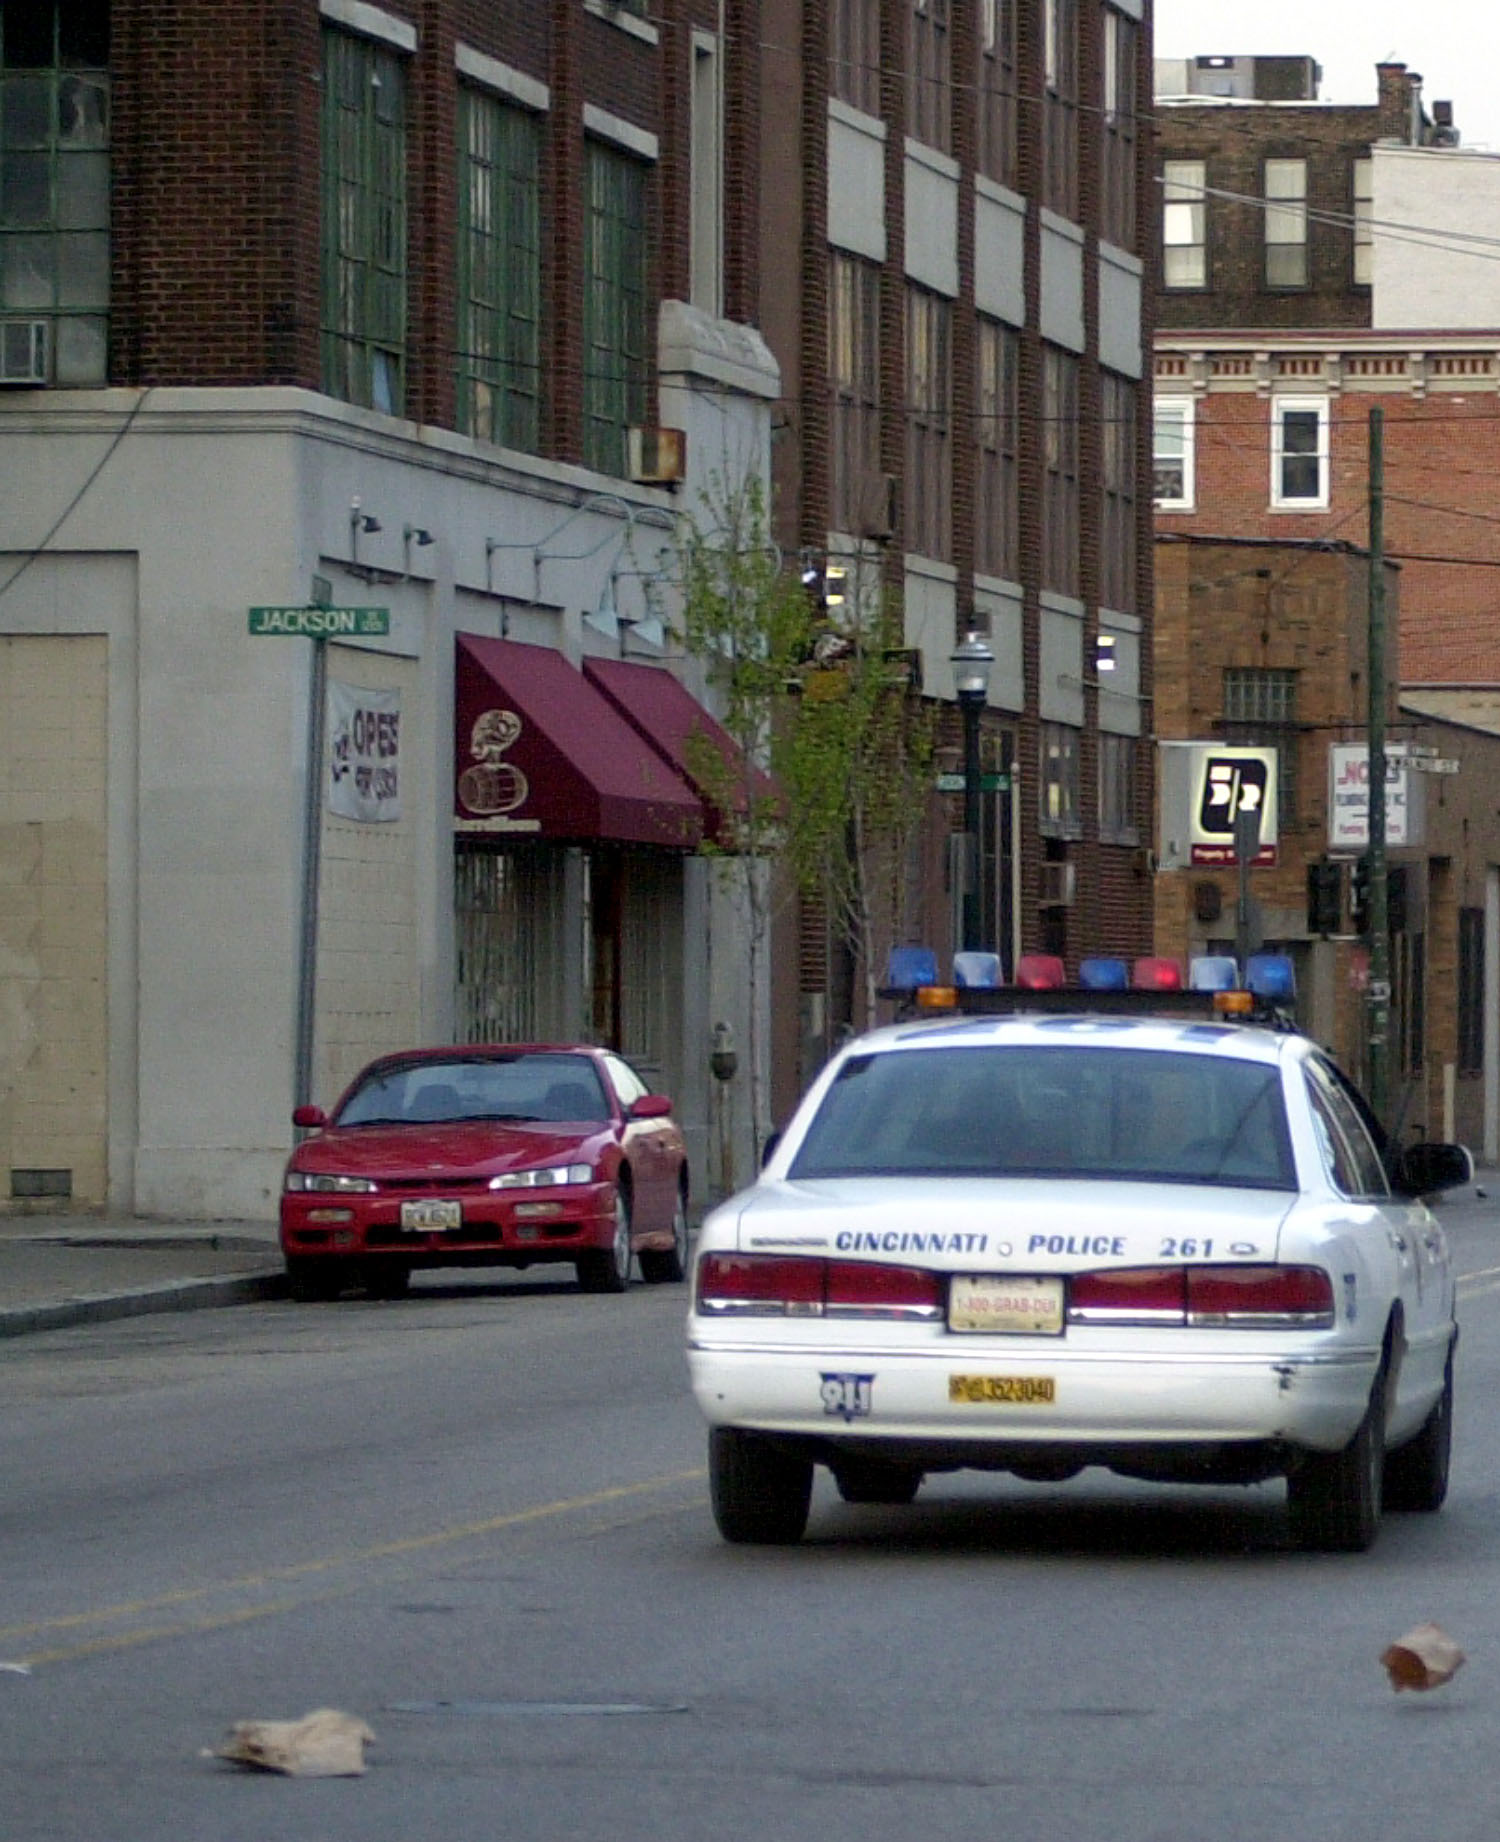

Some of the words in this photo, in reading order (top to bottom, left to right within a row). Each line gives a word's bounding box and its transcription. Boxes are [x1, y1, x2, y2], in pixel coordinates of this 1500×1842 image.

[256, 610, 356, 631] JACKSON
[836, 1231, 989, 1253] CINCINNATI
[1028, 1235, 1127, 1256] POLICE
[1159, 1238, 1215, 1258] 261
